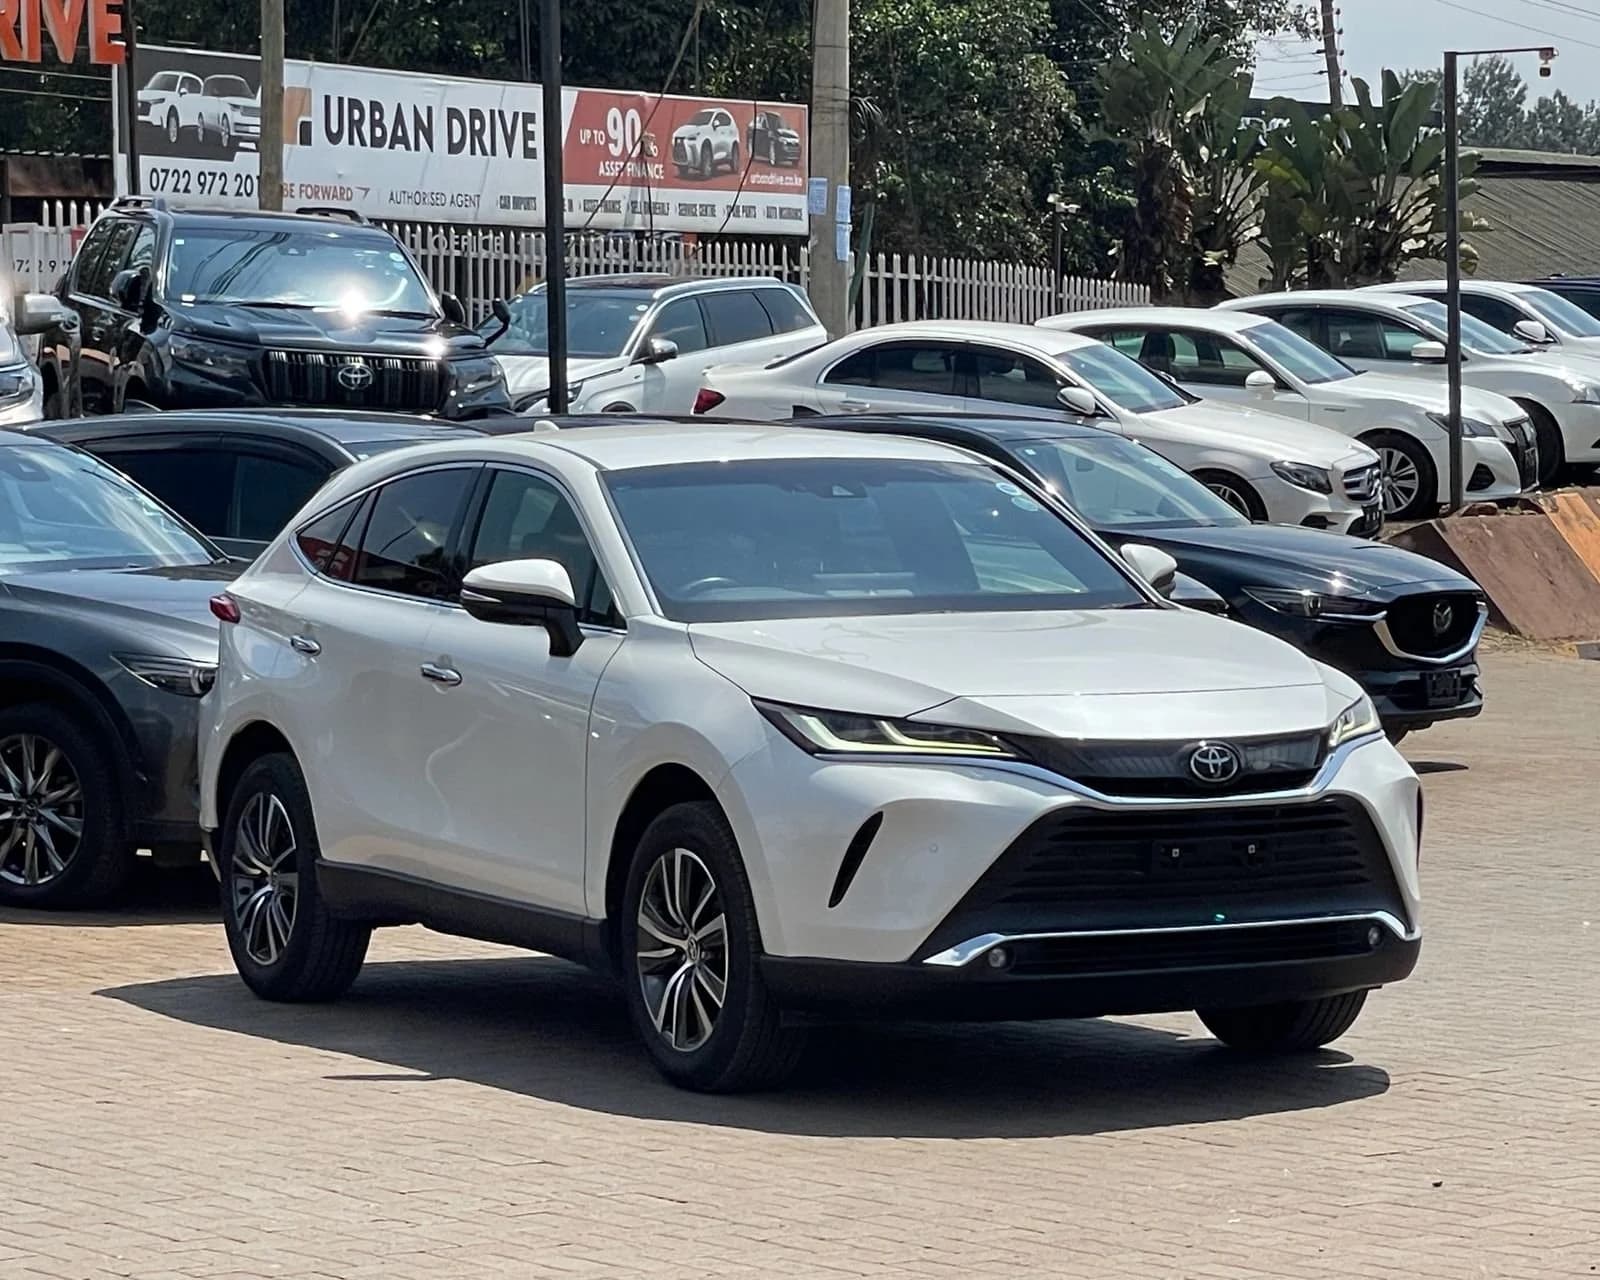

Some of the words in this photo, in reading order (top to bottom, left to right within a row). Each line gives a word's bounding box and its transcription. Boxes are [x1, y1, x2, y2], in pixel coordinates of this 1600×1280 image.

[324, 94, 434, 152] URBAN
[447, 107, 537, 160] DRIVE
[580, 129, 592, 145] UP
[593, 129, 605, 146] TO
[626, 162, 664, 179] FINANCE
[150, 167, 191, 194] 0722
[197, 171, 228, 196] 972
[234, 173, 260, 198] 20
[281, 182, 295, 199] BE
[299, 183, 353, 201] FORWARD
[388, 190, 447, 207] AUTHORISED
[449, 193, 480, 209] AGENT
